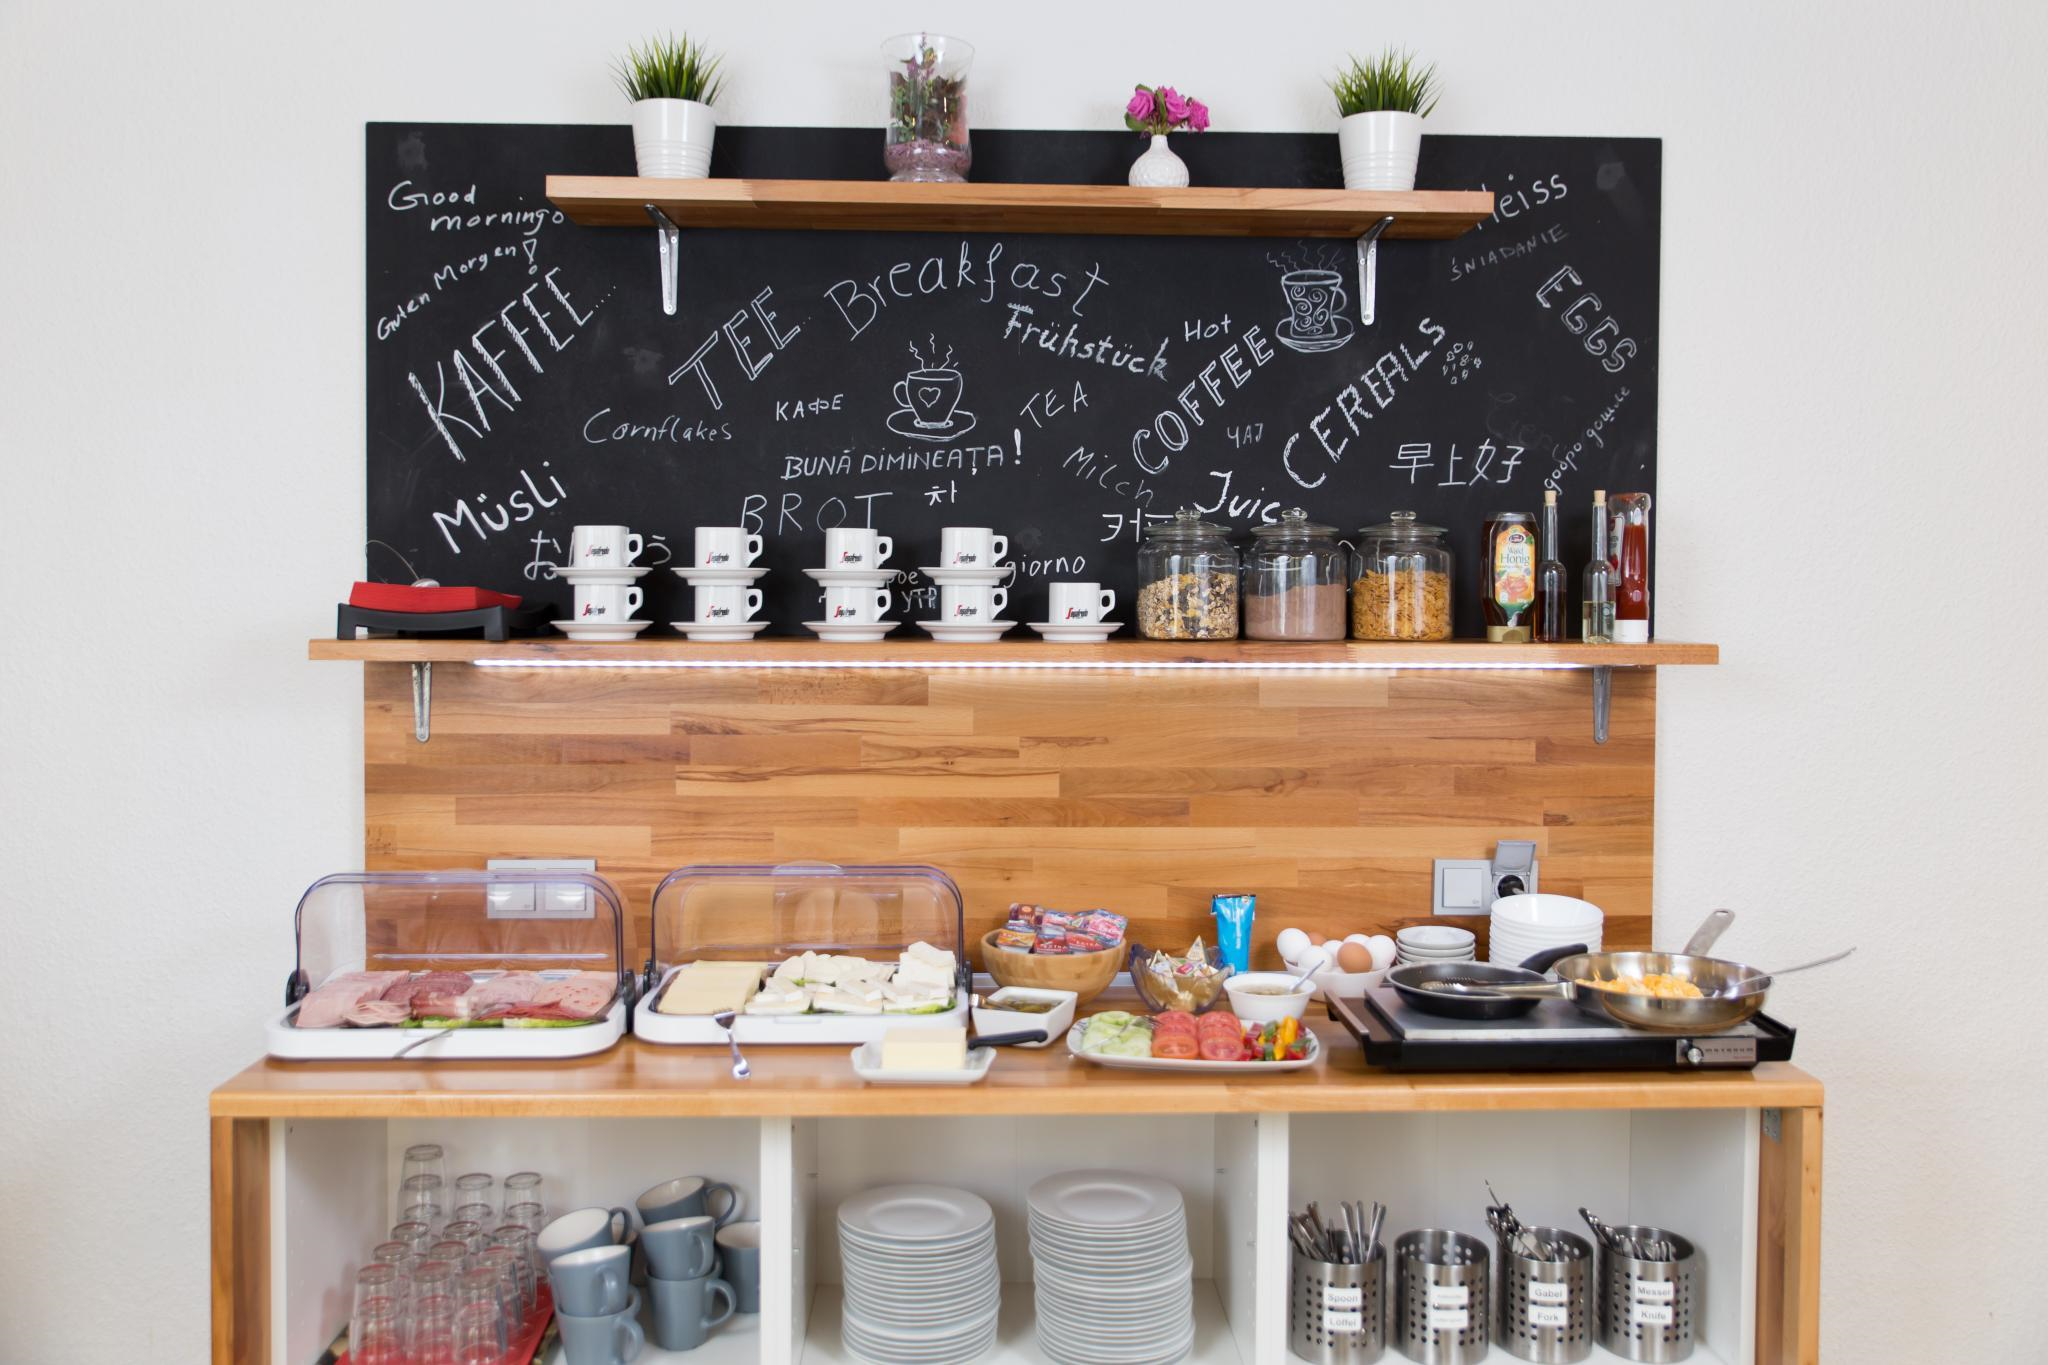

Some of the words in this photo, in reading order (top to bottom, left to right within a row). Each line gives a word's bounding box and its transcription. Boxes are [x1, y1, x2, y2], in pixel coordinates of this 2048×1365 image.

[388, 180, 477, 211] Good
[823, 240, 1110, 342] Breakfast
[377, 292, 431, 341] Guten
[1183, 313, 1232, 343] Hot
[1535, 264, 1638, 373] EGGS
[1002, 302, 1170, 383] Frühstück
[1019, 380, 1090, 429] TEA
[1131, 324, 1275, 475] COFFEE
[1283, 316, 1446, 489] CEREALS
[583, 407, 733, 444] Cornflakes
[1388, 437, 1526, 487] 早上好
[431, 460, 568, 554] Müsli
[740, 491, 894, 536] BROT
[1193, 470, 1304, 524] Juic
[1004, 554, 1086, 589] giorno
[1500, 553, 1530, 568] Honig
[1327, 1293, 1359, 1305] Spoon
[1534, 1288, 1563, 1299] Gabel
[1637, 1286, 1672, 1297] Messer
[1537, 1311, 1559, 1321] Fork
[1640, 1309, 1667, 1320] Knife
